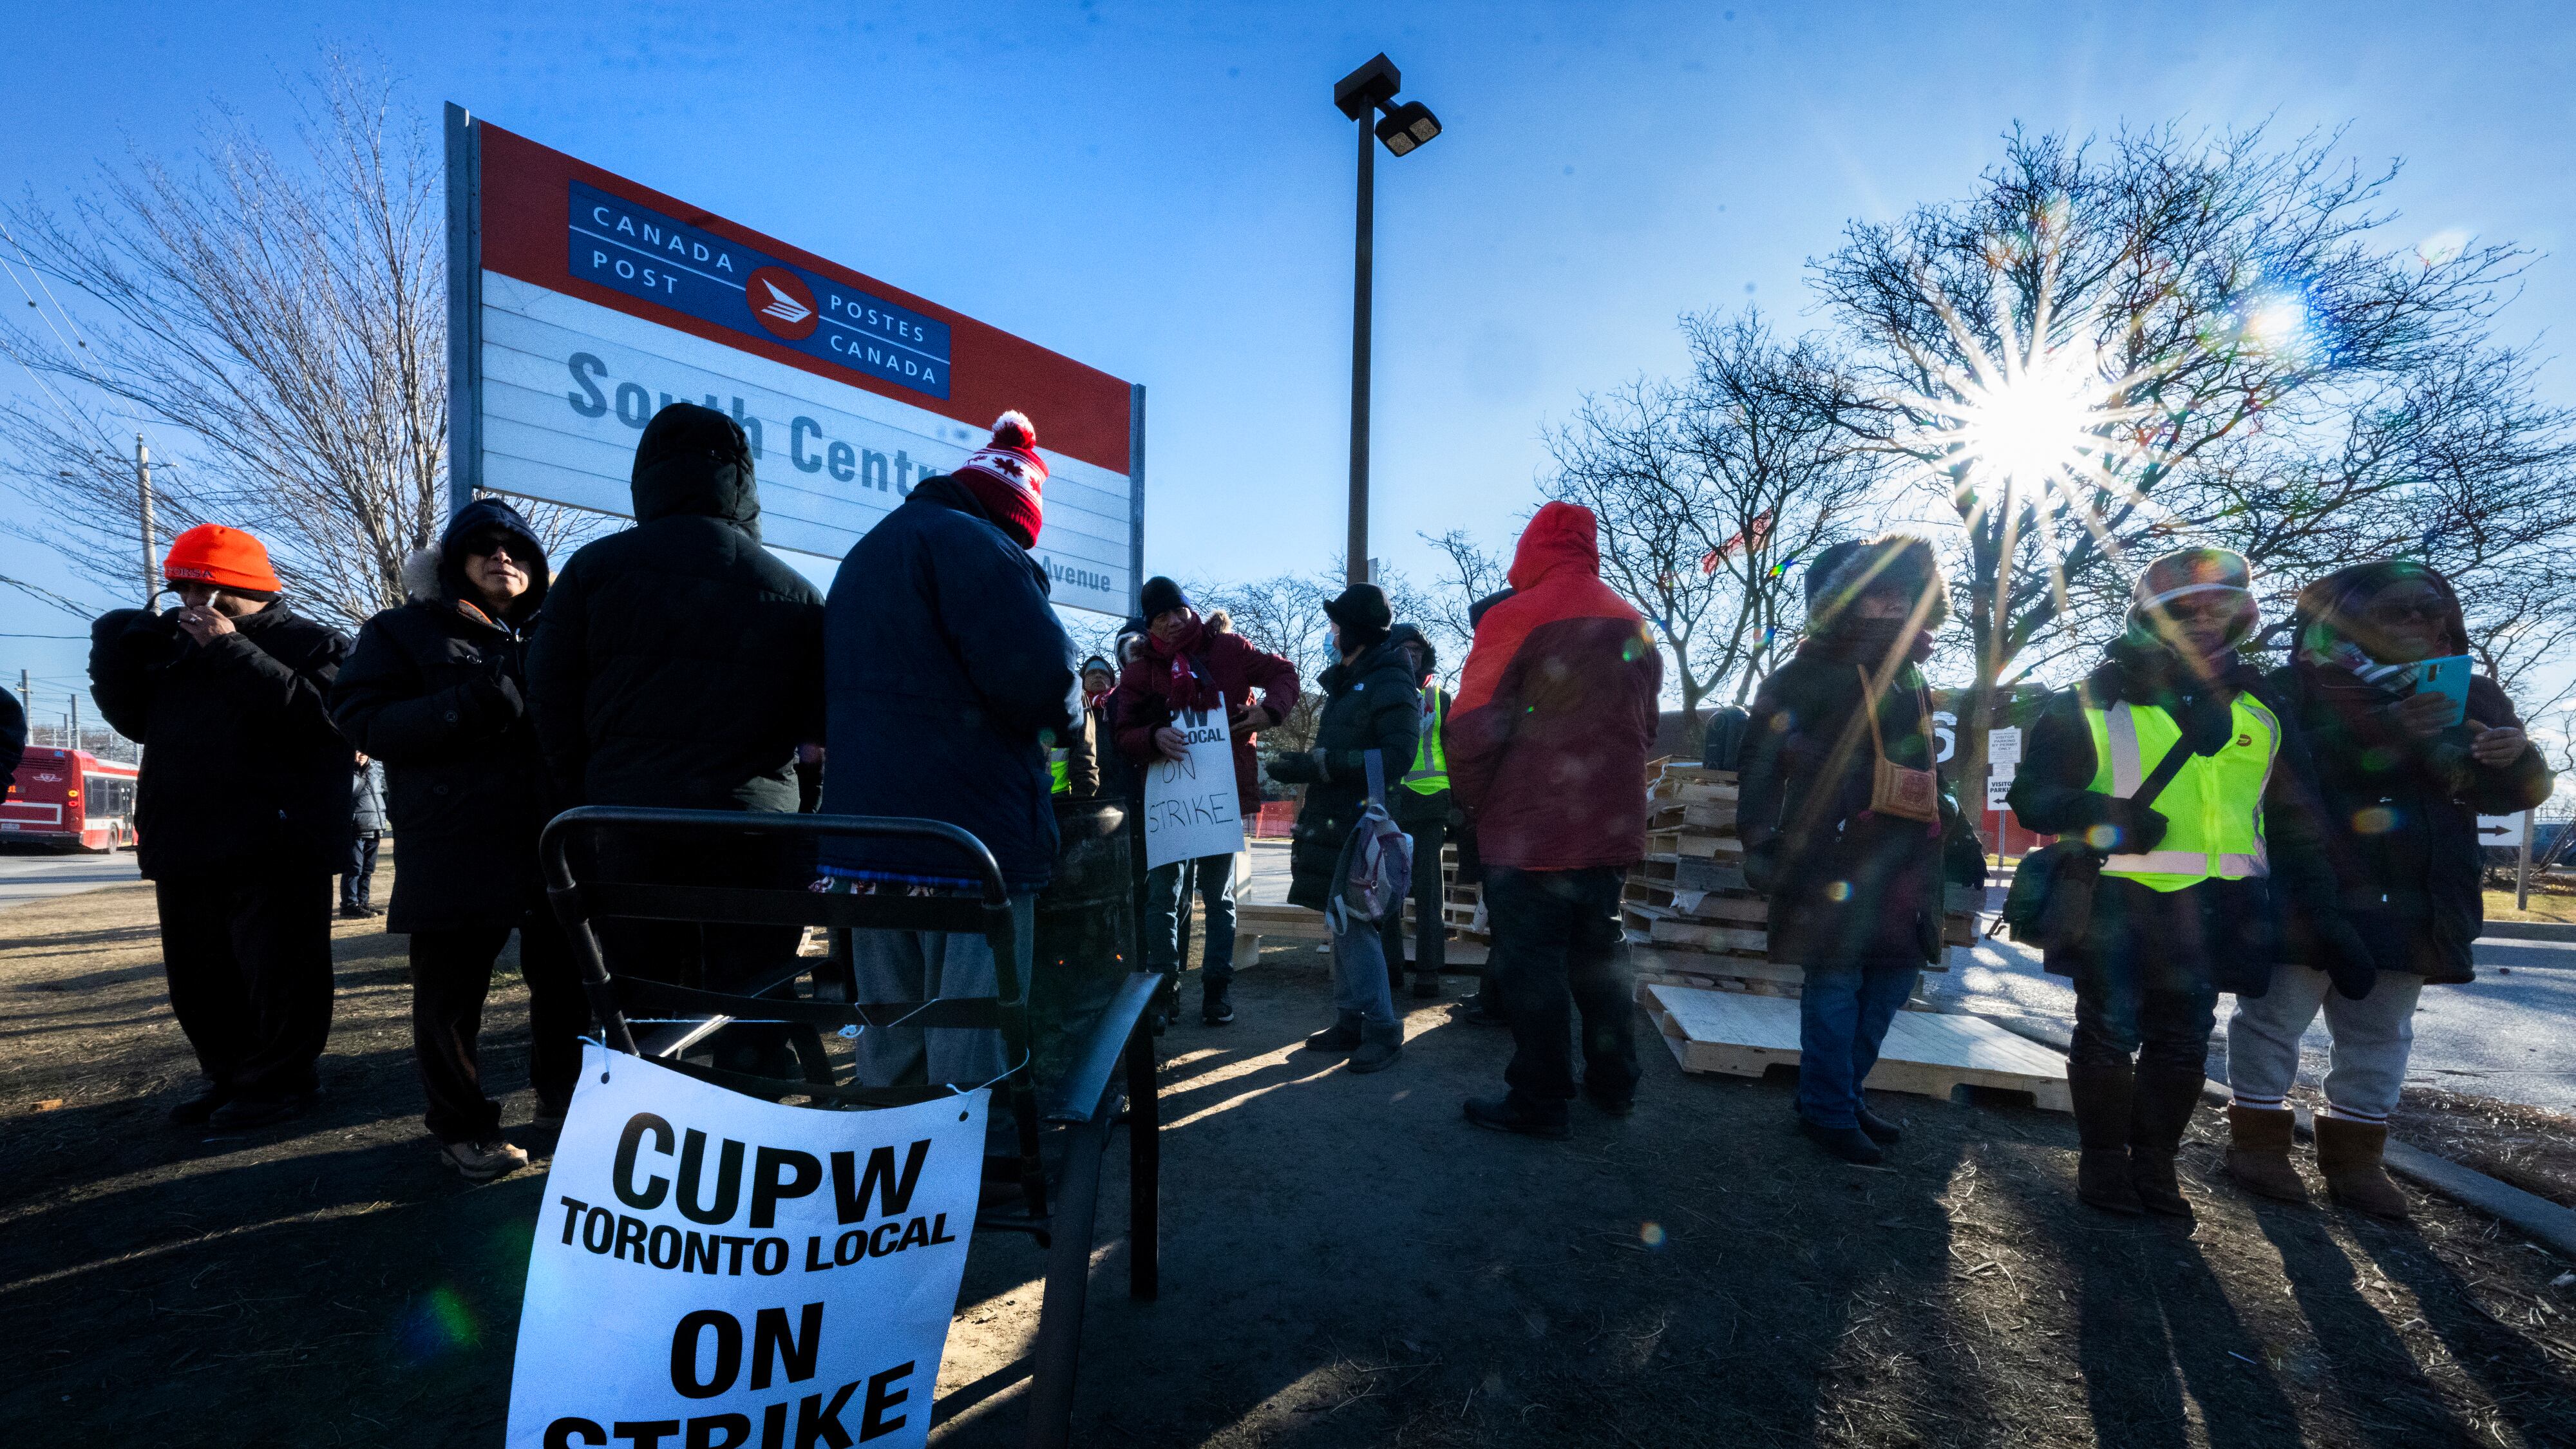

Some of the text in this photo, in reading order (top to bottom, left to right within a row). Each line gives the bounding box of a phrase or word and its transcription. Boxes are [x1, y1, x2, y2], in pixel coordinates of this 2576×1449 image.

[593, 206, 733, 272] CANADA
[593, 250, 677, 294] POST
[831, 294, 923, 342] POSTES
[830, 335, 936, 384] CANADA
[568, 352, 938, 497] Soh Centr
[1042, 555, 1111, 592] Avenue
[1182, 728, 1226, 746] OCAL
[1150, 792, 1234, 833] STRIKE
[612, 1112, 932, 1228] CUPW
[560, 1196, 956, 1276] TORONTO LOCAL
[670, 1302, 825, 1399] ON
